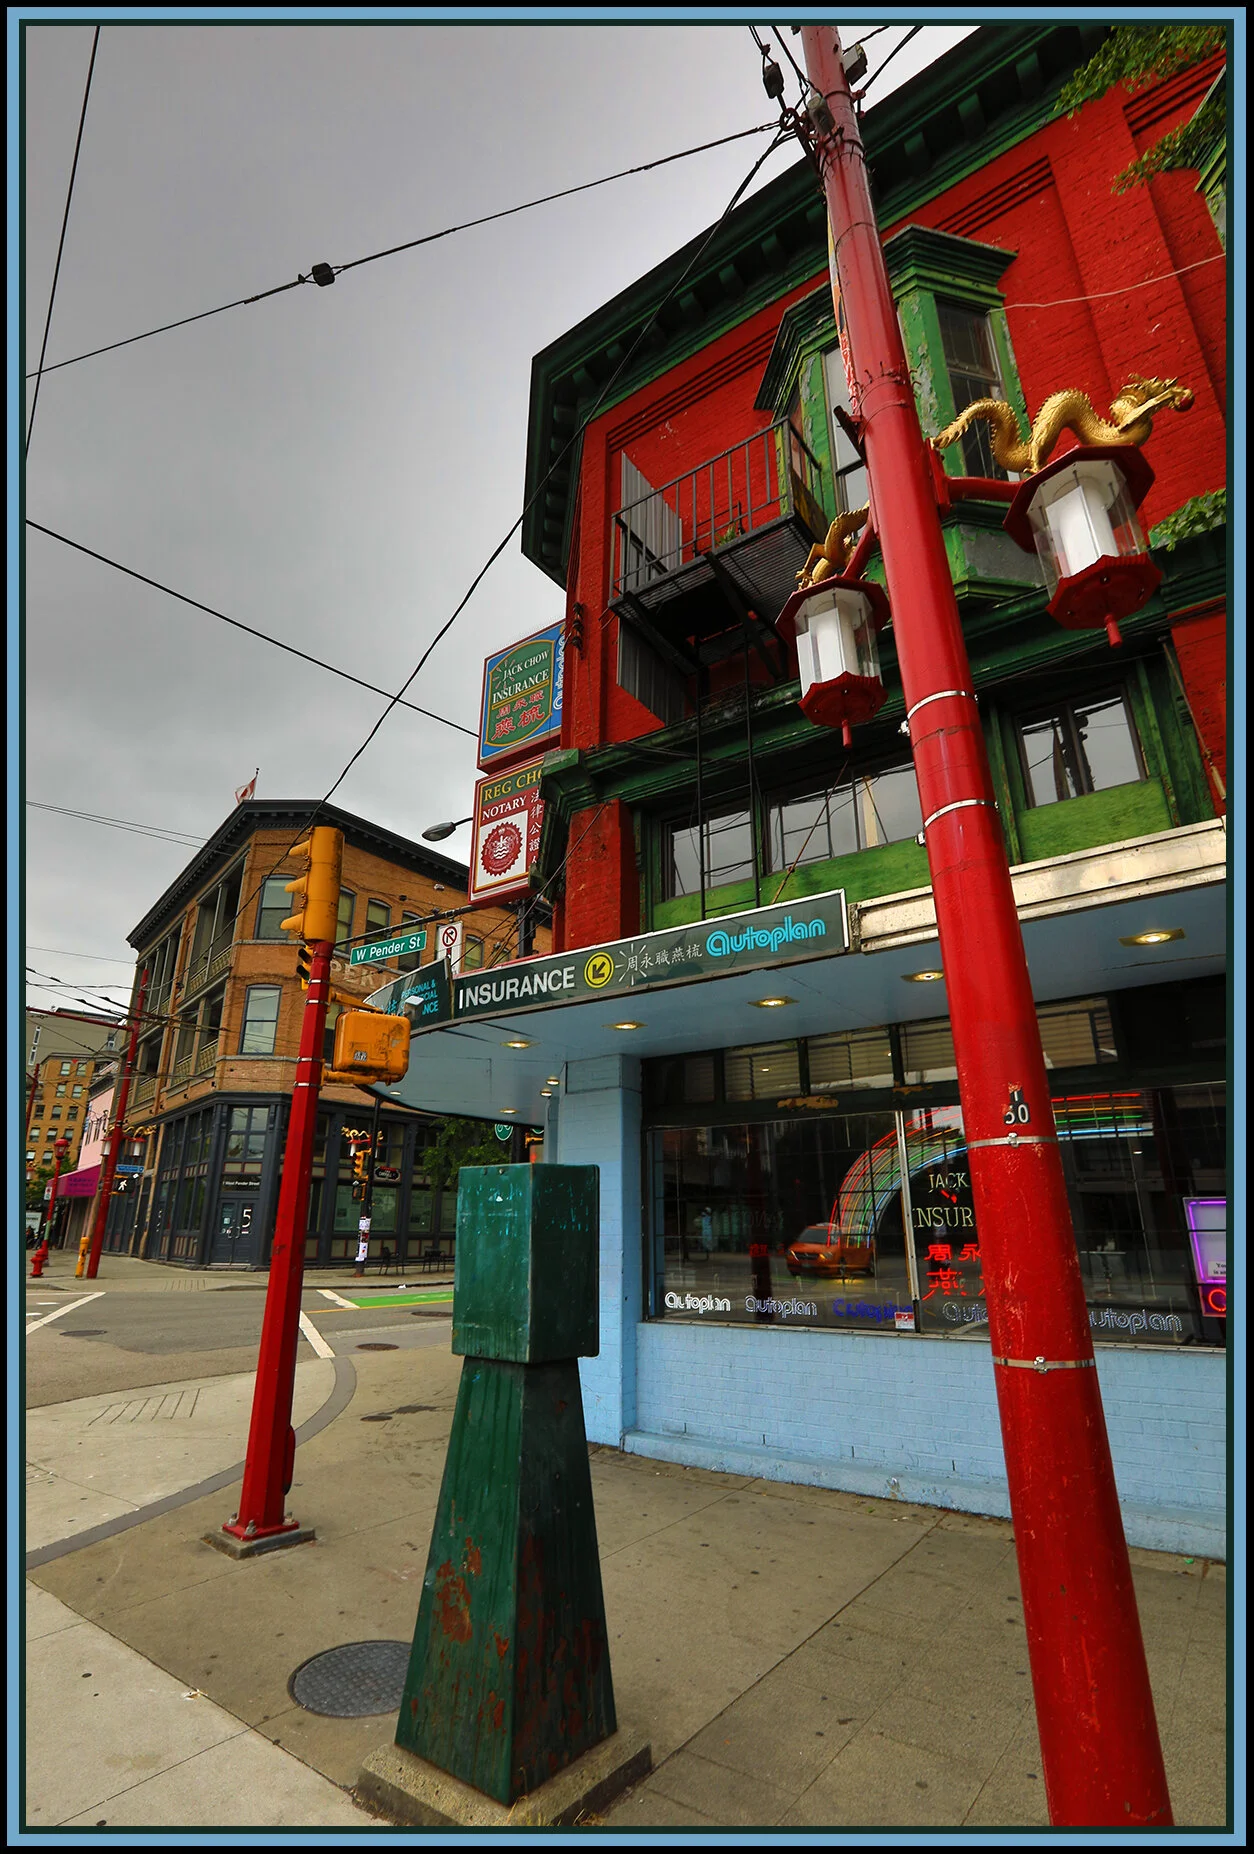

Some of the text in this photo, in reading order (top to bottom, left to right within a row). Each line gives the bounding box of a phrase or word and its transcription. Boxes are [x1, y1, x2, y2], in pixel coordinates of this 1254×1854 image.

[503, 649, 549, 682] JACK CHOW
[492, 668, 549, 704] INSURANCE
[483, 780, 512, 802] REG
[482, 795, 527, 821] NOTARY
[356, 935, 421, 961] W Pender St
[459, 966, 576, 1010] INSURANCE
[928, 1172, 970, 1194] JACK
[912, 1206, 975, 1229] NSUR
